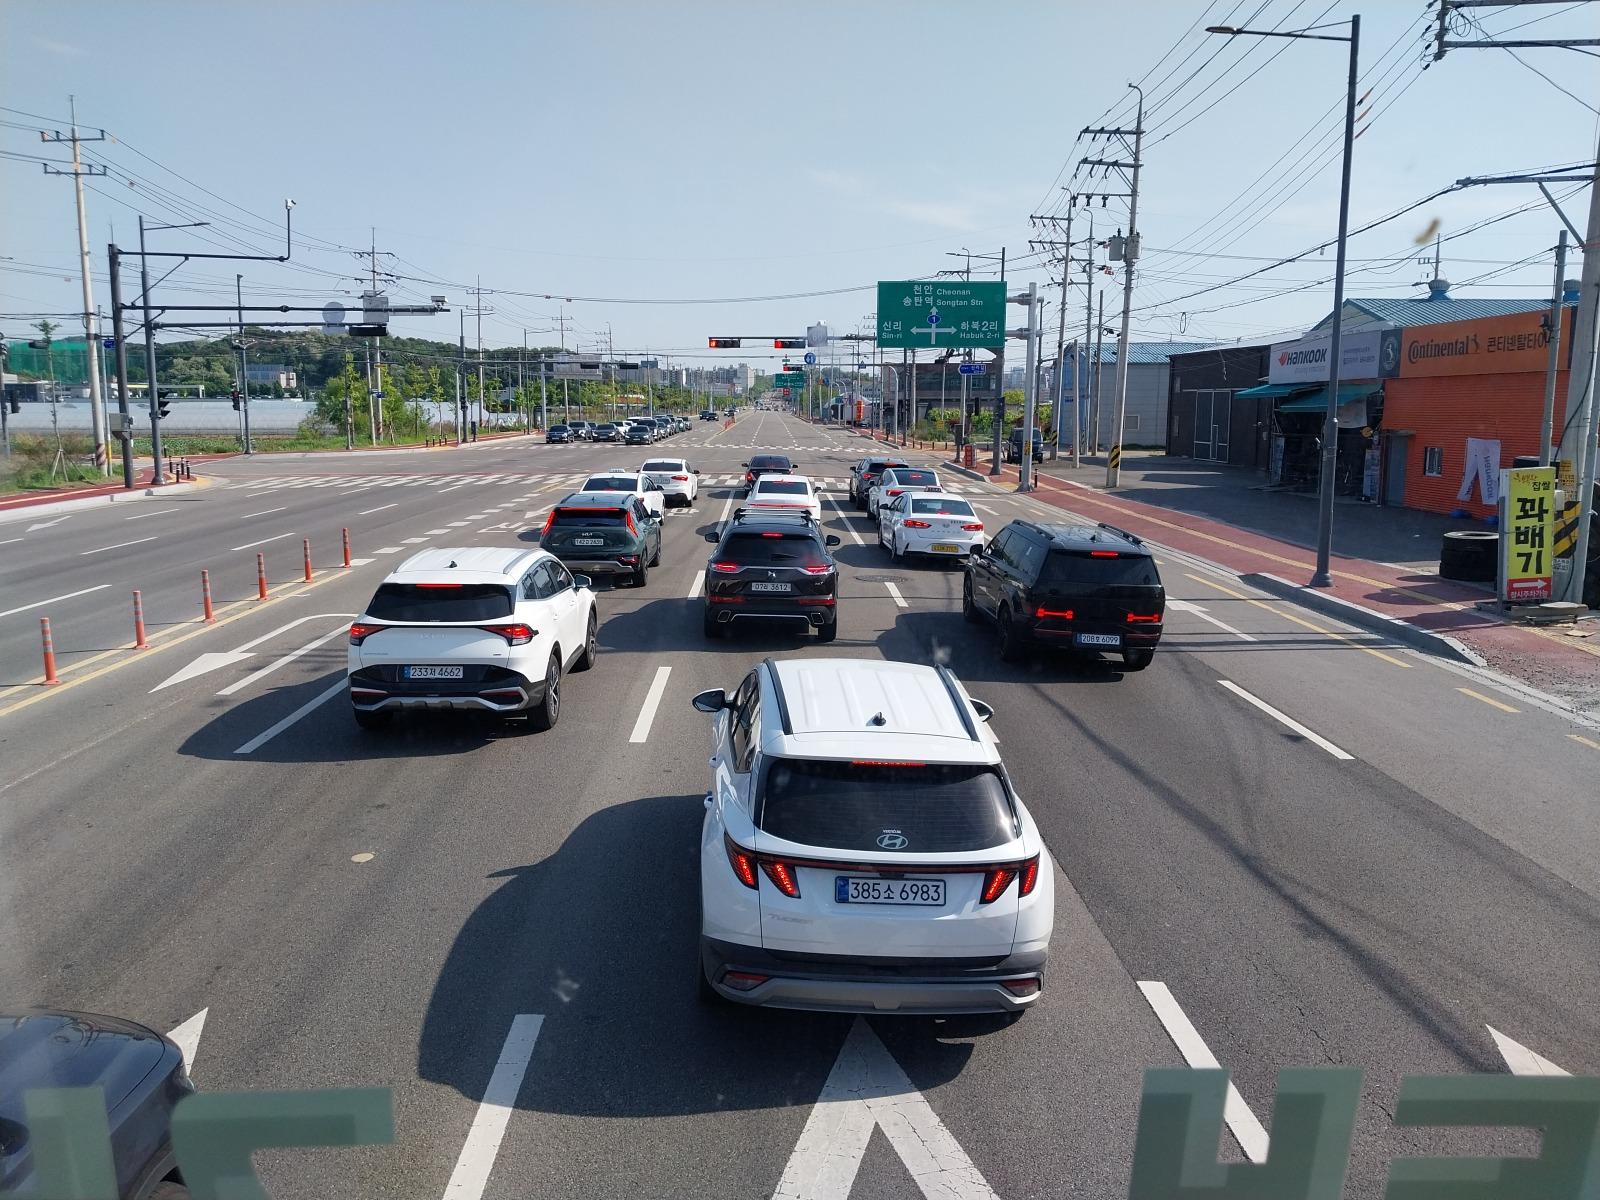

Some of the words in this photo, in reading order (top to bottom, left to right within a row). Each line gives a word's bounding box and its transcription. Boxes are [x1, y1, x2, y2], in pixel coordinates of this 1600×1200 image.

[913, 284, 933, 295] 천안
[936, 287, 971, 296] Cheonan
[902, 296, 934, 307] 송탄역
[936, 299, 968, 307] Songtan
[882, 321, 902, 331] 신리
[960, 321, 998, 331] 하북2리
[1408, 335, 1469, 364] Continental
[437, 667, 461, 677] 4662
[850, 882, 894, 900] 385소
[899, 883, 941, 901] 6983
